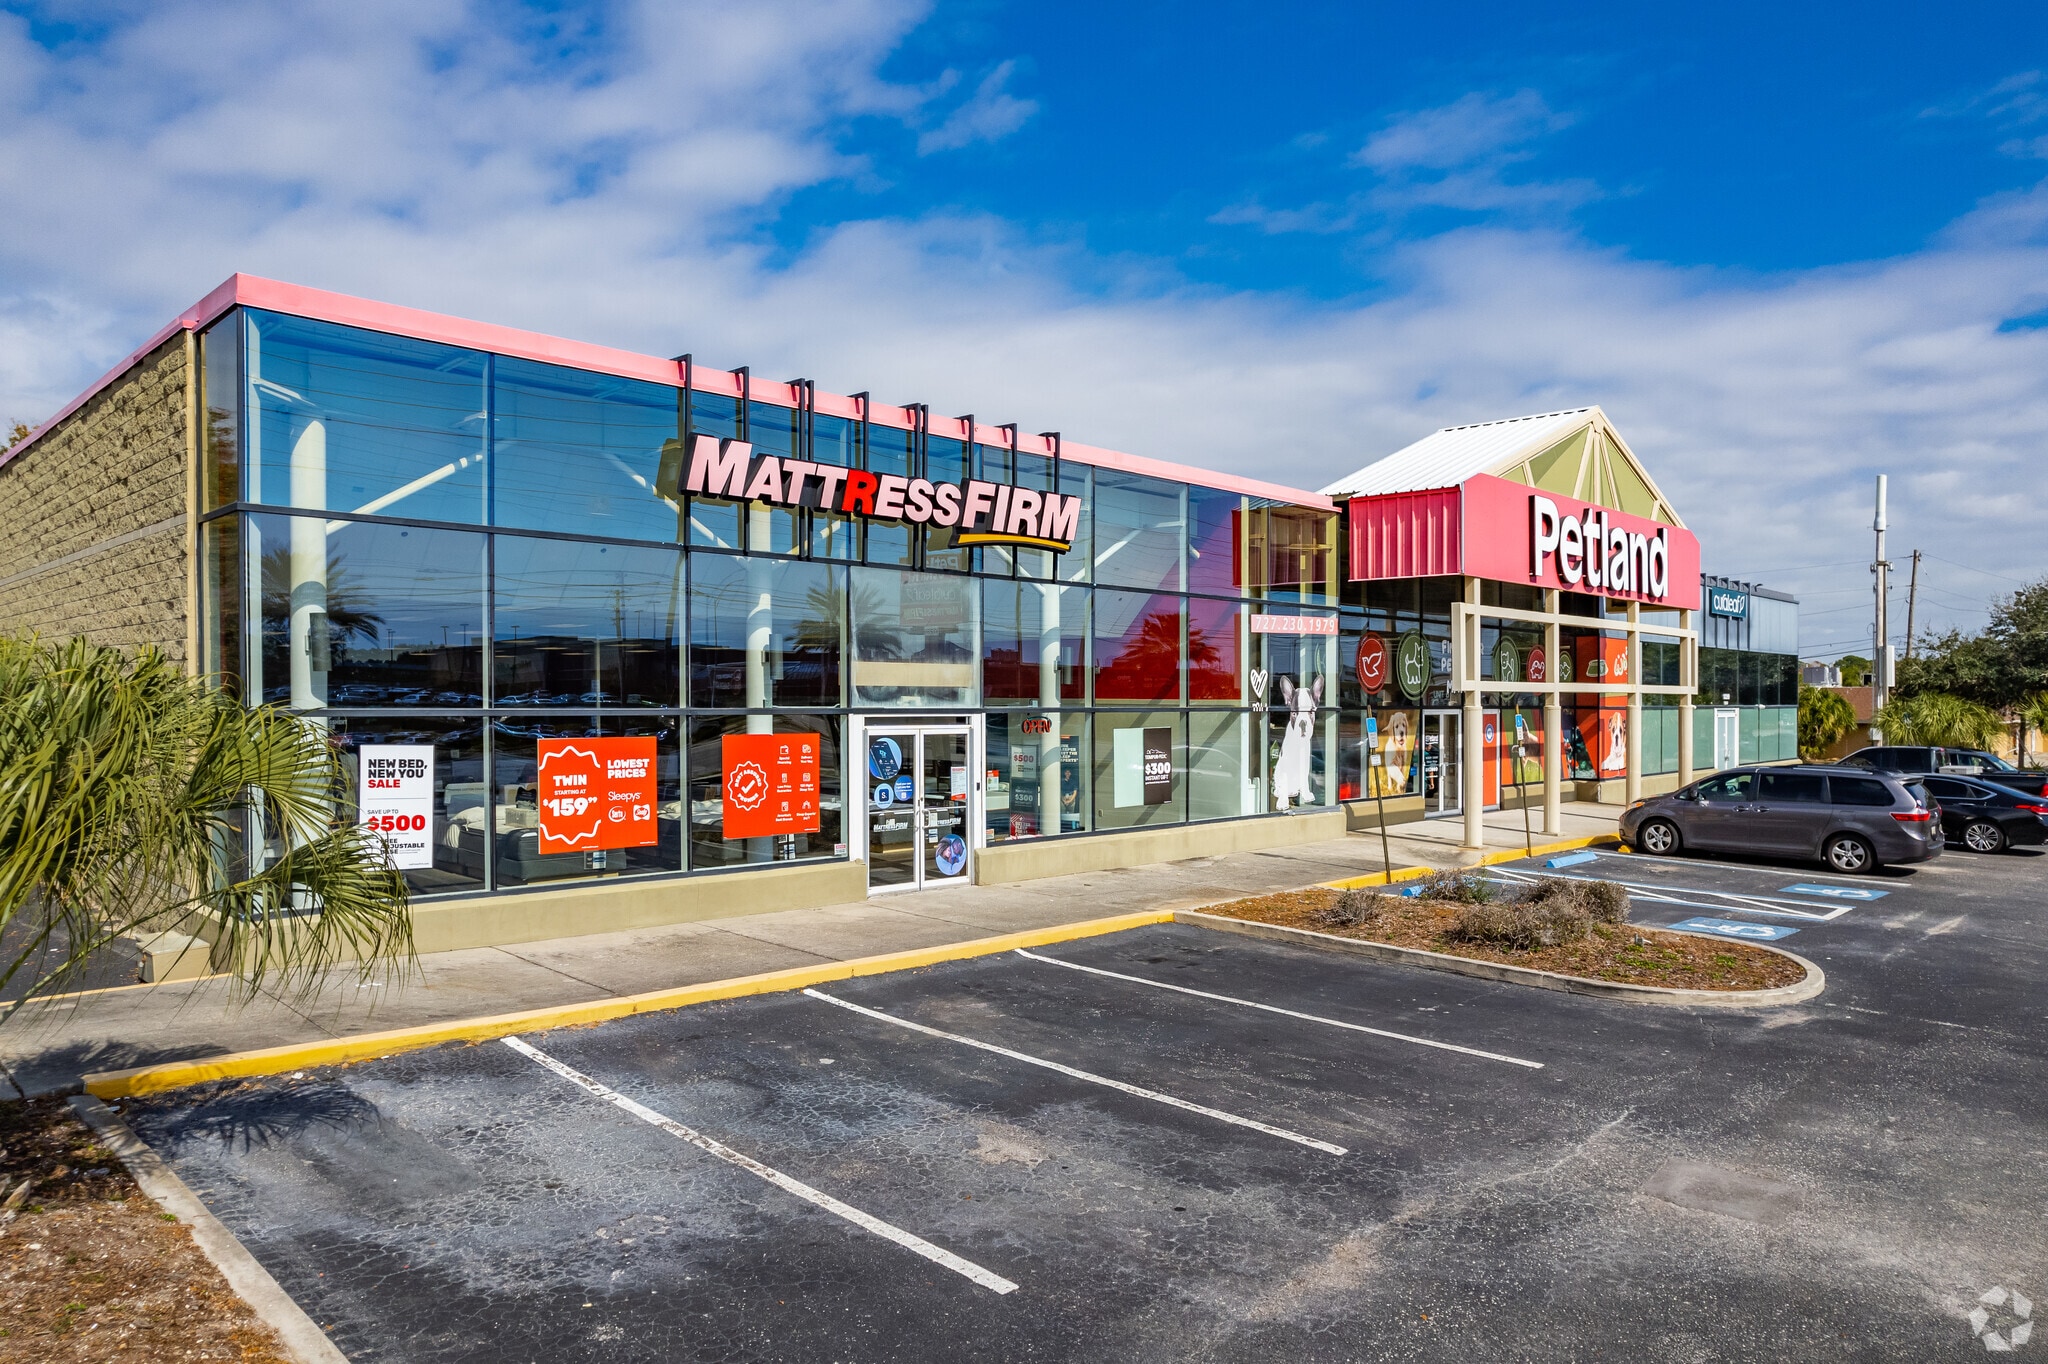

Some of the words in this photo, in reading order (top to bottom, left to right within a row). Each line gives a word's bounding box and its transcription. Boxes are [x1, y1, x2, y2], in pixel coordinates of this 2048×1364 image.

[1530, 494, 1669, 599] Petland
[1713, 593, 1742, 613] curaleaf
[1255, 616, 1335, 632] 727.230.1979
[1023, 719, 1051, 734] OPEN
[368, 759, 396, 769] NEW
[398, 759, 428, 769] BED,
[607, 758, 650, 769] LOWEST
[1013, 754, 1034, 763] $500
[368, 769, 396, 778] NEW
[398, 769, 424, 778] YOU
[607, 768, 647, 779] PRICES
[1144, 761, 1171, 775] $300
[368, 779, 401, 788] SALE
[553, 774, 587, 787] TWIN
[1014, 793, 1034, 802] $300
[367, 814, 426, 832] $500
